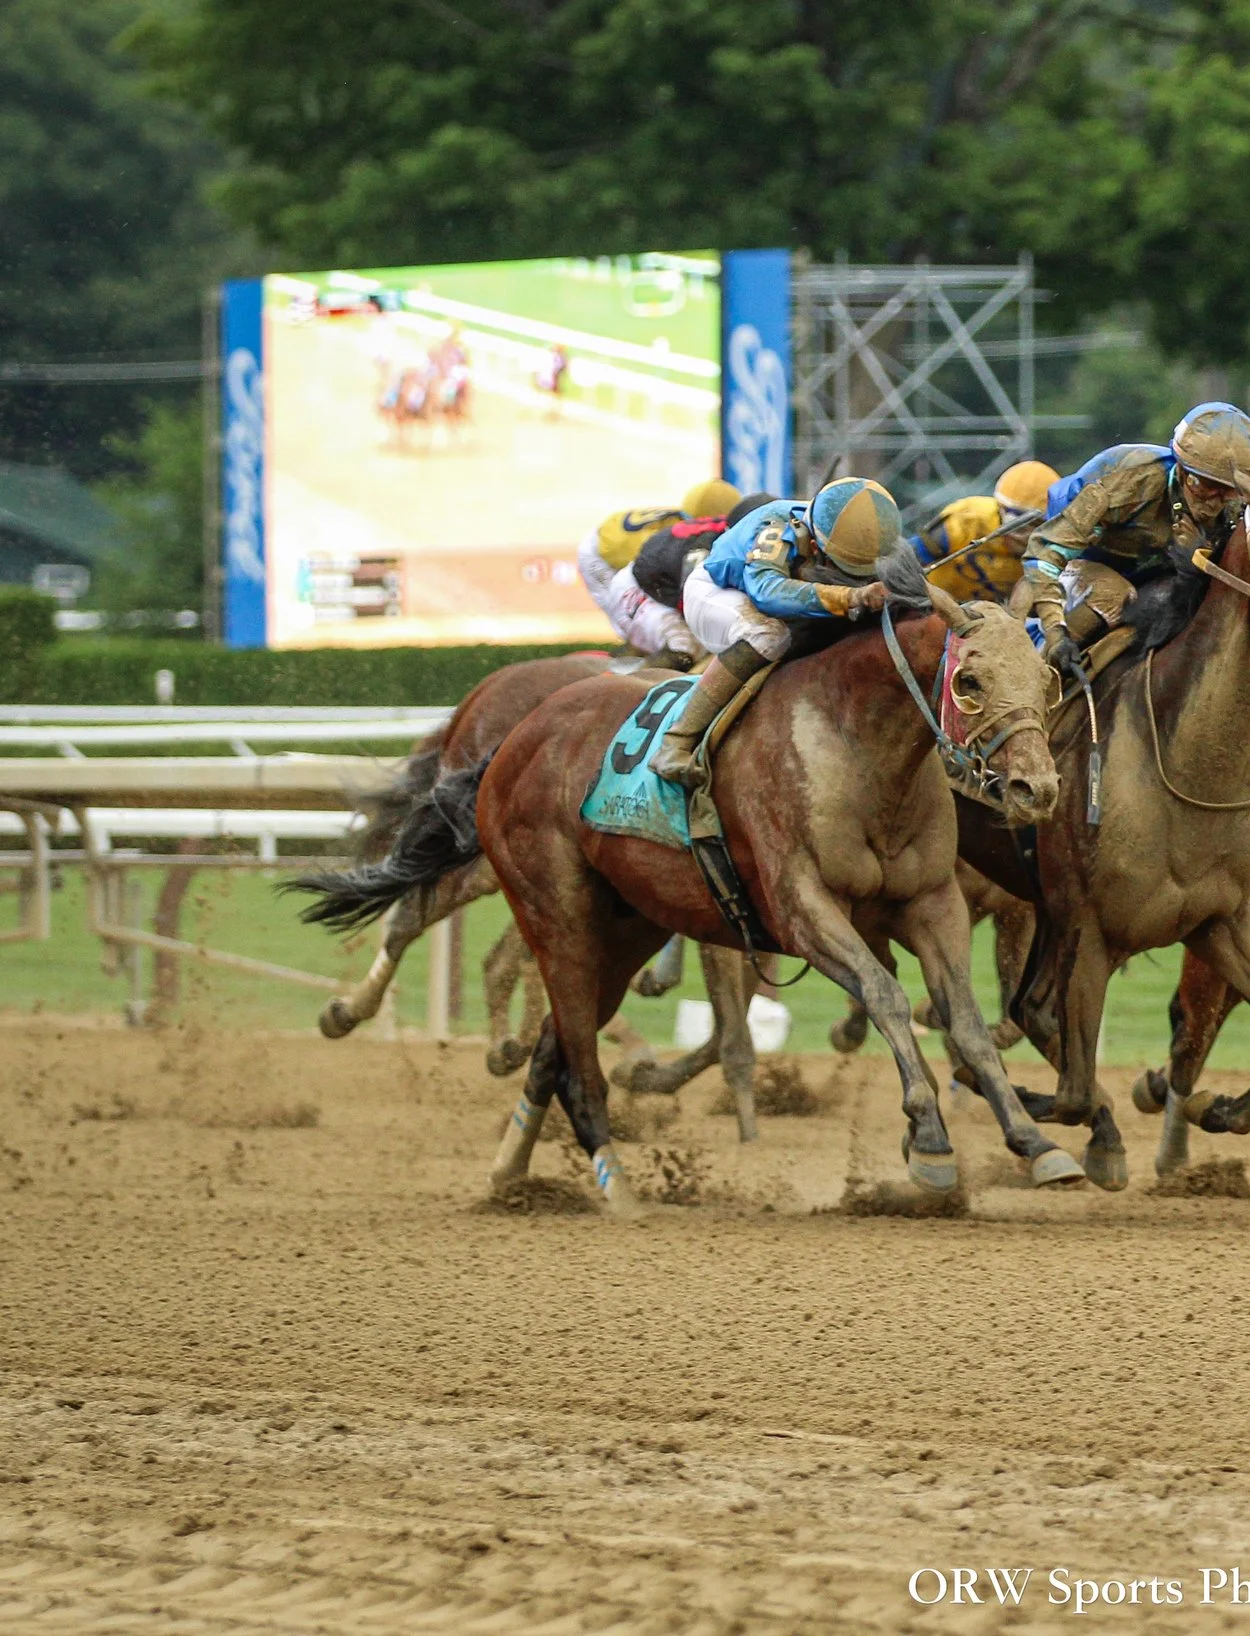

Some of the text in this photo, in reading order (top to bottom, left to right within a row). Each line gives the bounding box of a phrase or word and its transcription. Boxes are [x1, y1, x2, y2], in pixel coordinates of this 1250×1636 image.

[728, 323, 788, 499] For
[751, 527, 784, 561] 9
[611, 679, 695, 774] 9
